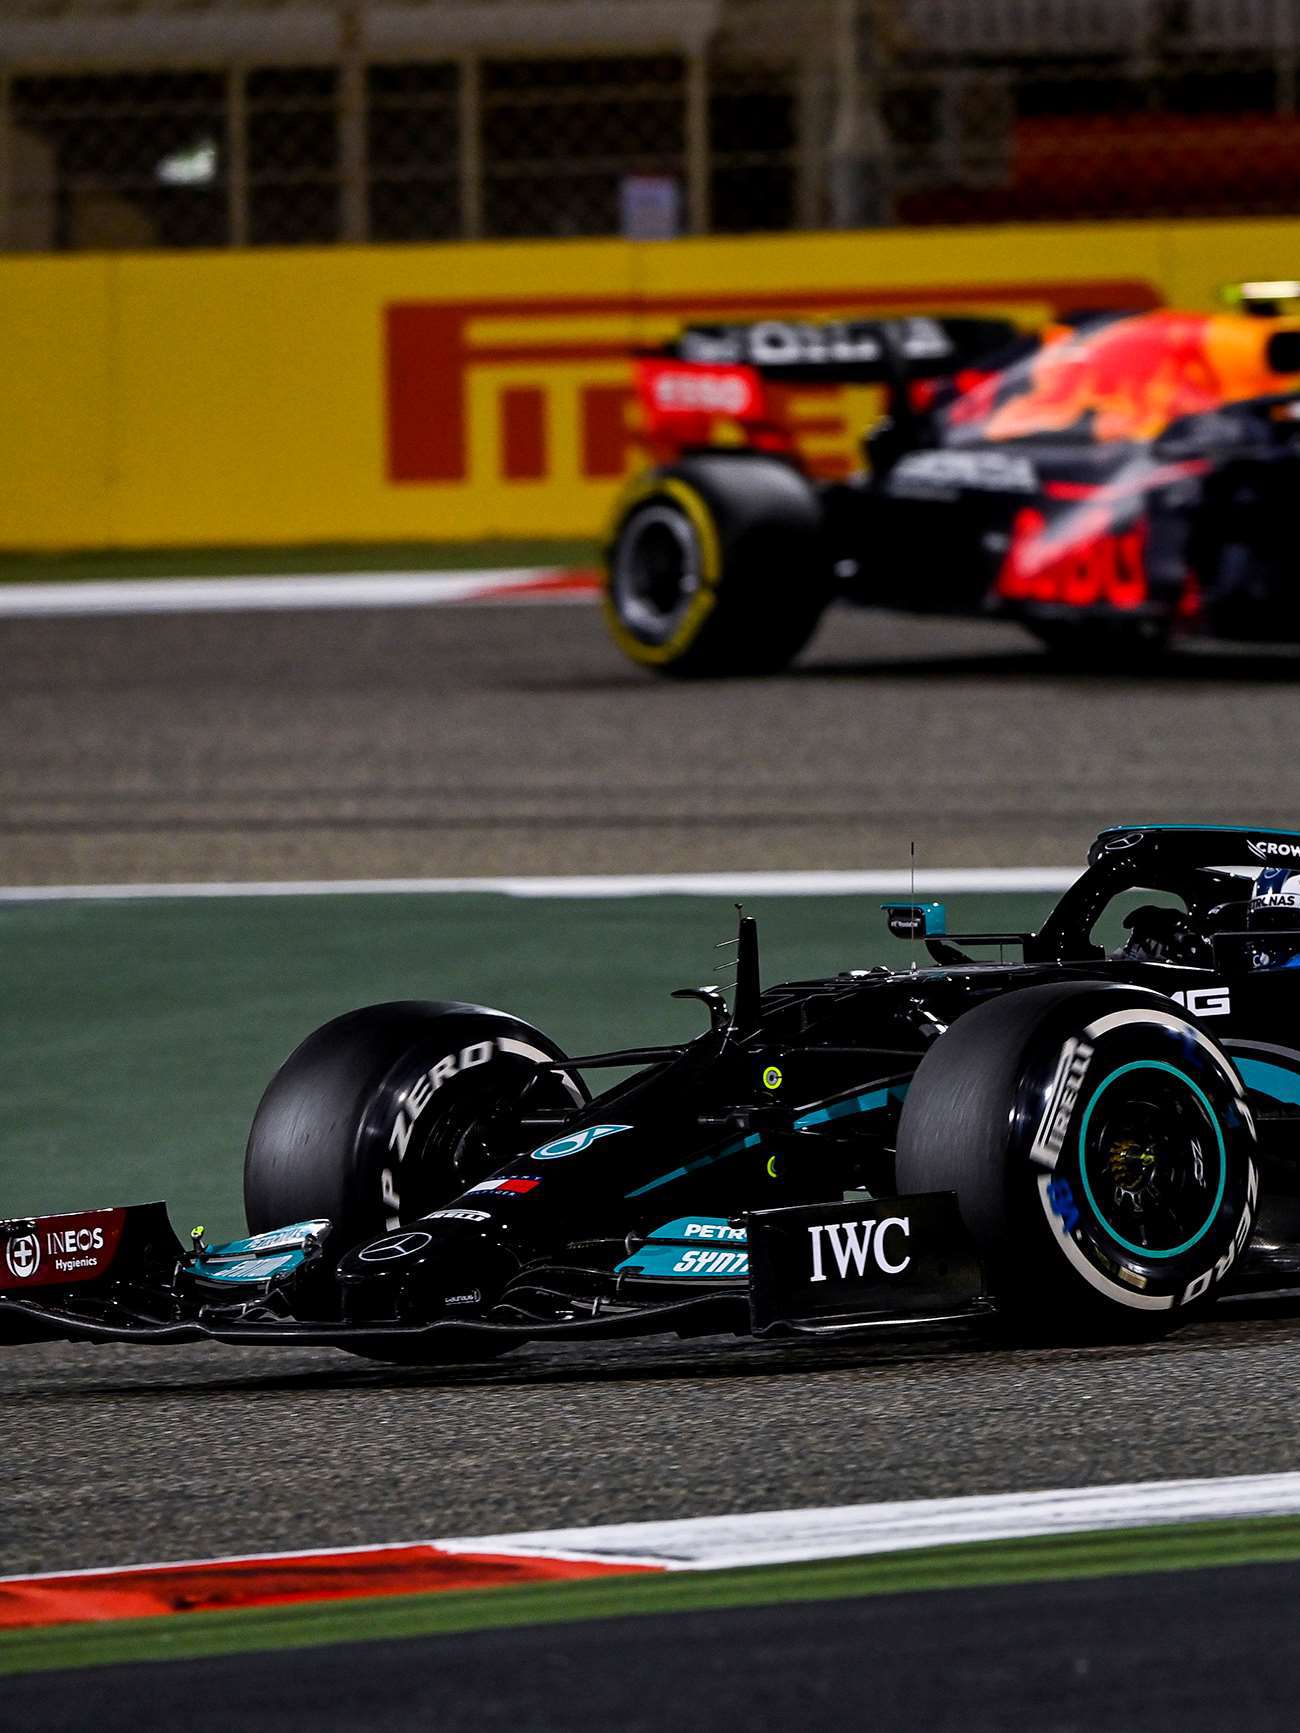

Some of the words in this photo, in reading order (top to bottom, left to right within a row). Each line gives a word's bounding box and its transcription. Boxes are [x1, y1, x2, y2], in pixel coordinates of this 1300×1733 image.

[387, 1039, 494, 1163] ZERO
[47, 1226, 105, 1255] INEOS
[683, 1223, 748, 1240] PETR
[672, 1250, 749, 1273] SYNT
[807, 1216, 911, 1282] IWC
[54, 1255, 98, 1272] Hygienics
